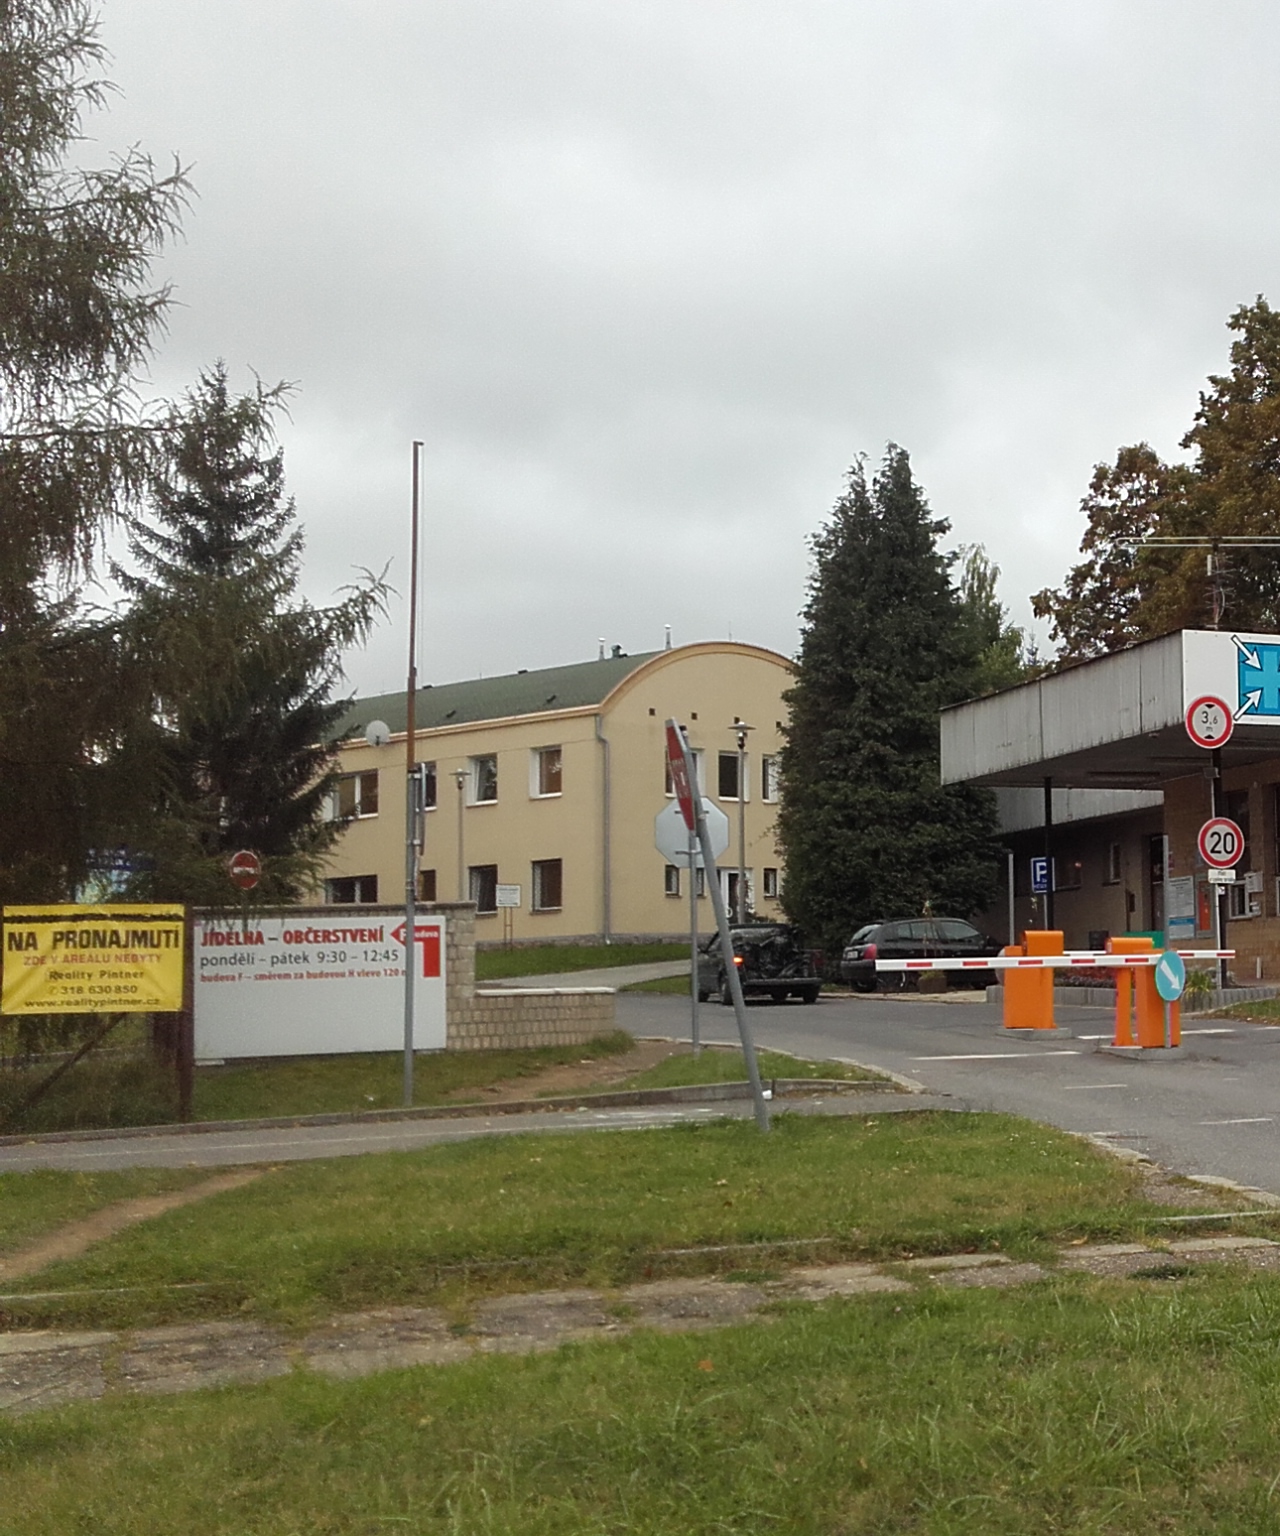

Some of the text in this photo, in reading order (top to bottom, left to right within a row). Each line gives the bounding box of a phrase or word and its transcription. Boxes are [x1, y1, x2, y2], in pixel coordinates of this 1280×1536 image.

[1209, 832, 1235, 854] 20
[1036, 862, 1047, 882] P
[8, 925, 179, 951] NA PRONAJMUTÍ
[201, 929, 264, 946] JÍDELNA
[283, 925, 384, 945] OBČERSTVENÍ
[414, 930, 439, 938] udova
[24, 955, 47, 966] ZDE
[200, 952, 255, 969] pondělí
[271, 951, 310, 967] pátek
[317, 951, 346, 963] 9:30
[363, 949, 399, 962] 12:45
[50, 970, 144, 981] Reality Pintner
[383, 968, 400, 976] 120
[61, 985, 138, 995] 318 630 850
